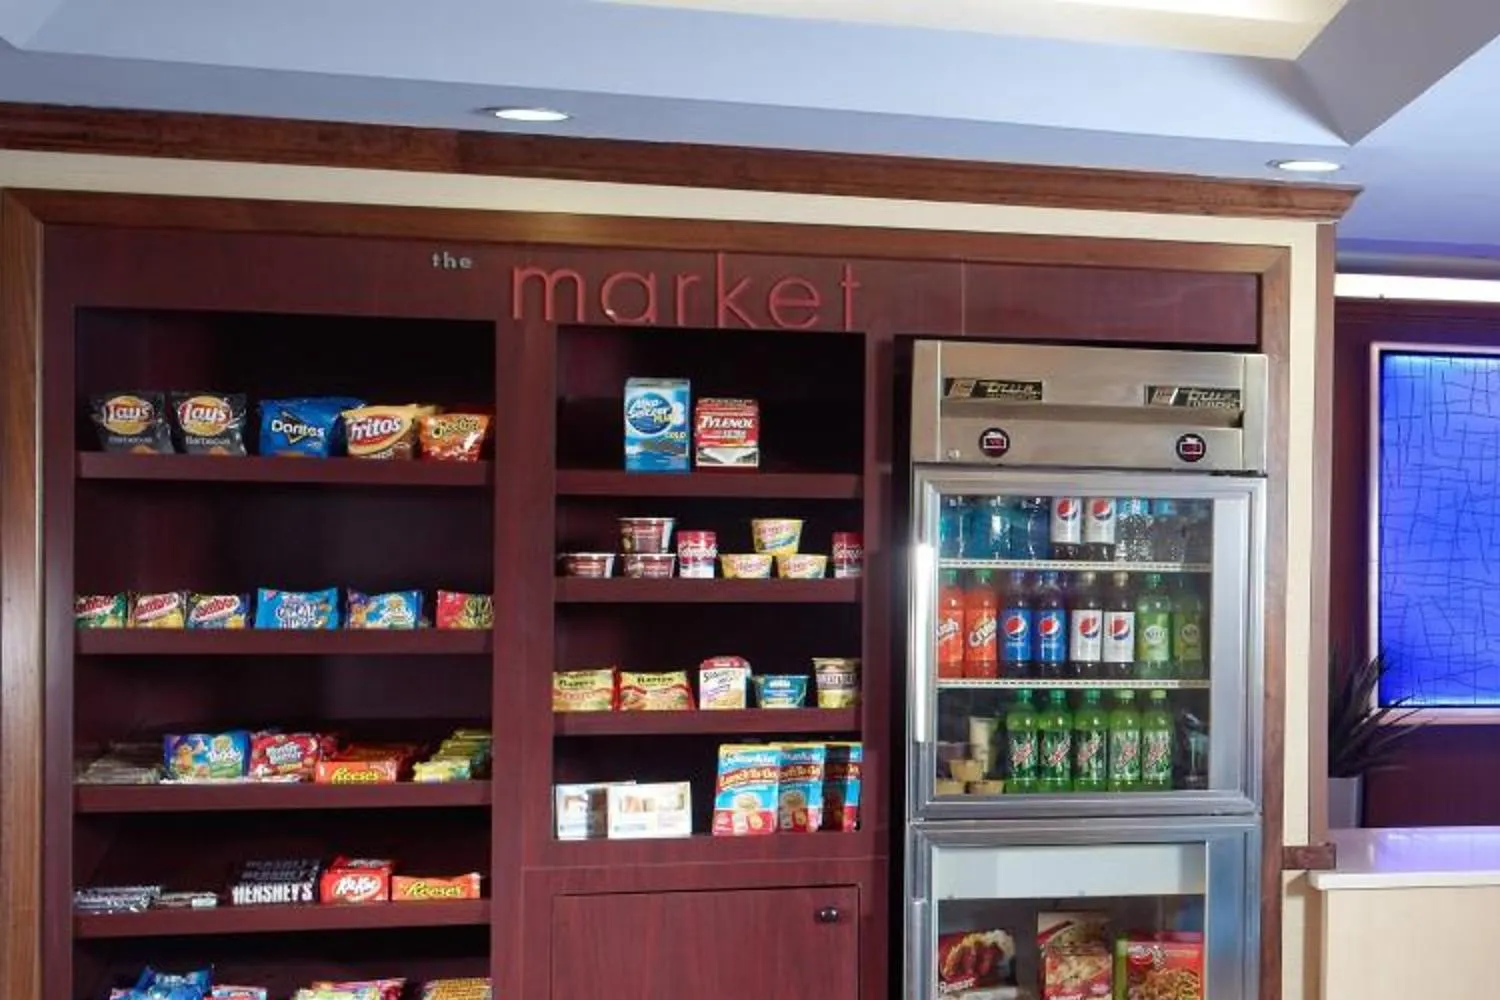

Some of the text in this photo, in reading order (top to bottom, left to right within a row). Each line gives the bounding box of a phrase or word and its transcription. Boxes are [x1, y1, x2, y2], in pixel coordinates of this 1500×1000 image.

[432, 250, 862, 331] the market
[271, 418, 325, 439] Doritos
[700, 415, 753, 429] TYLENOL
[232, 881, 313, 905] HERSHEY'S
